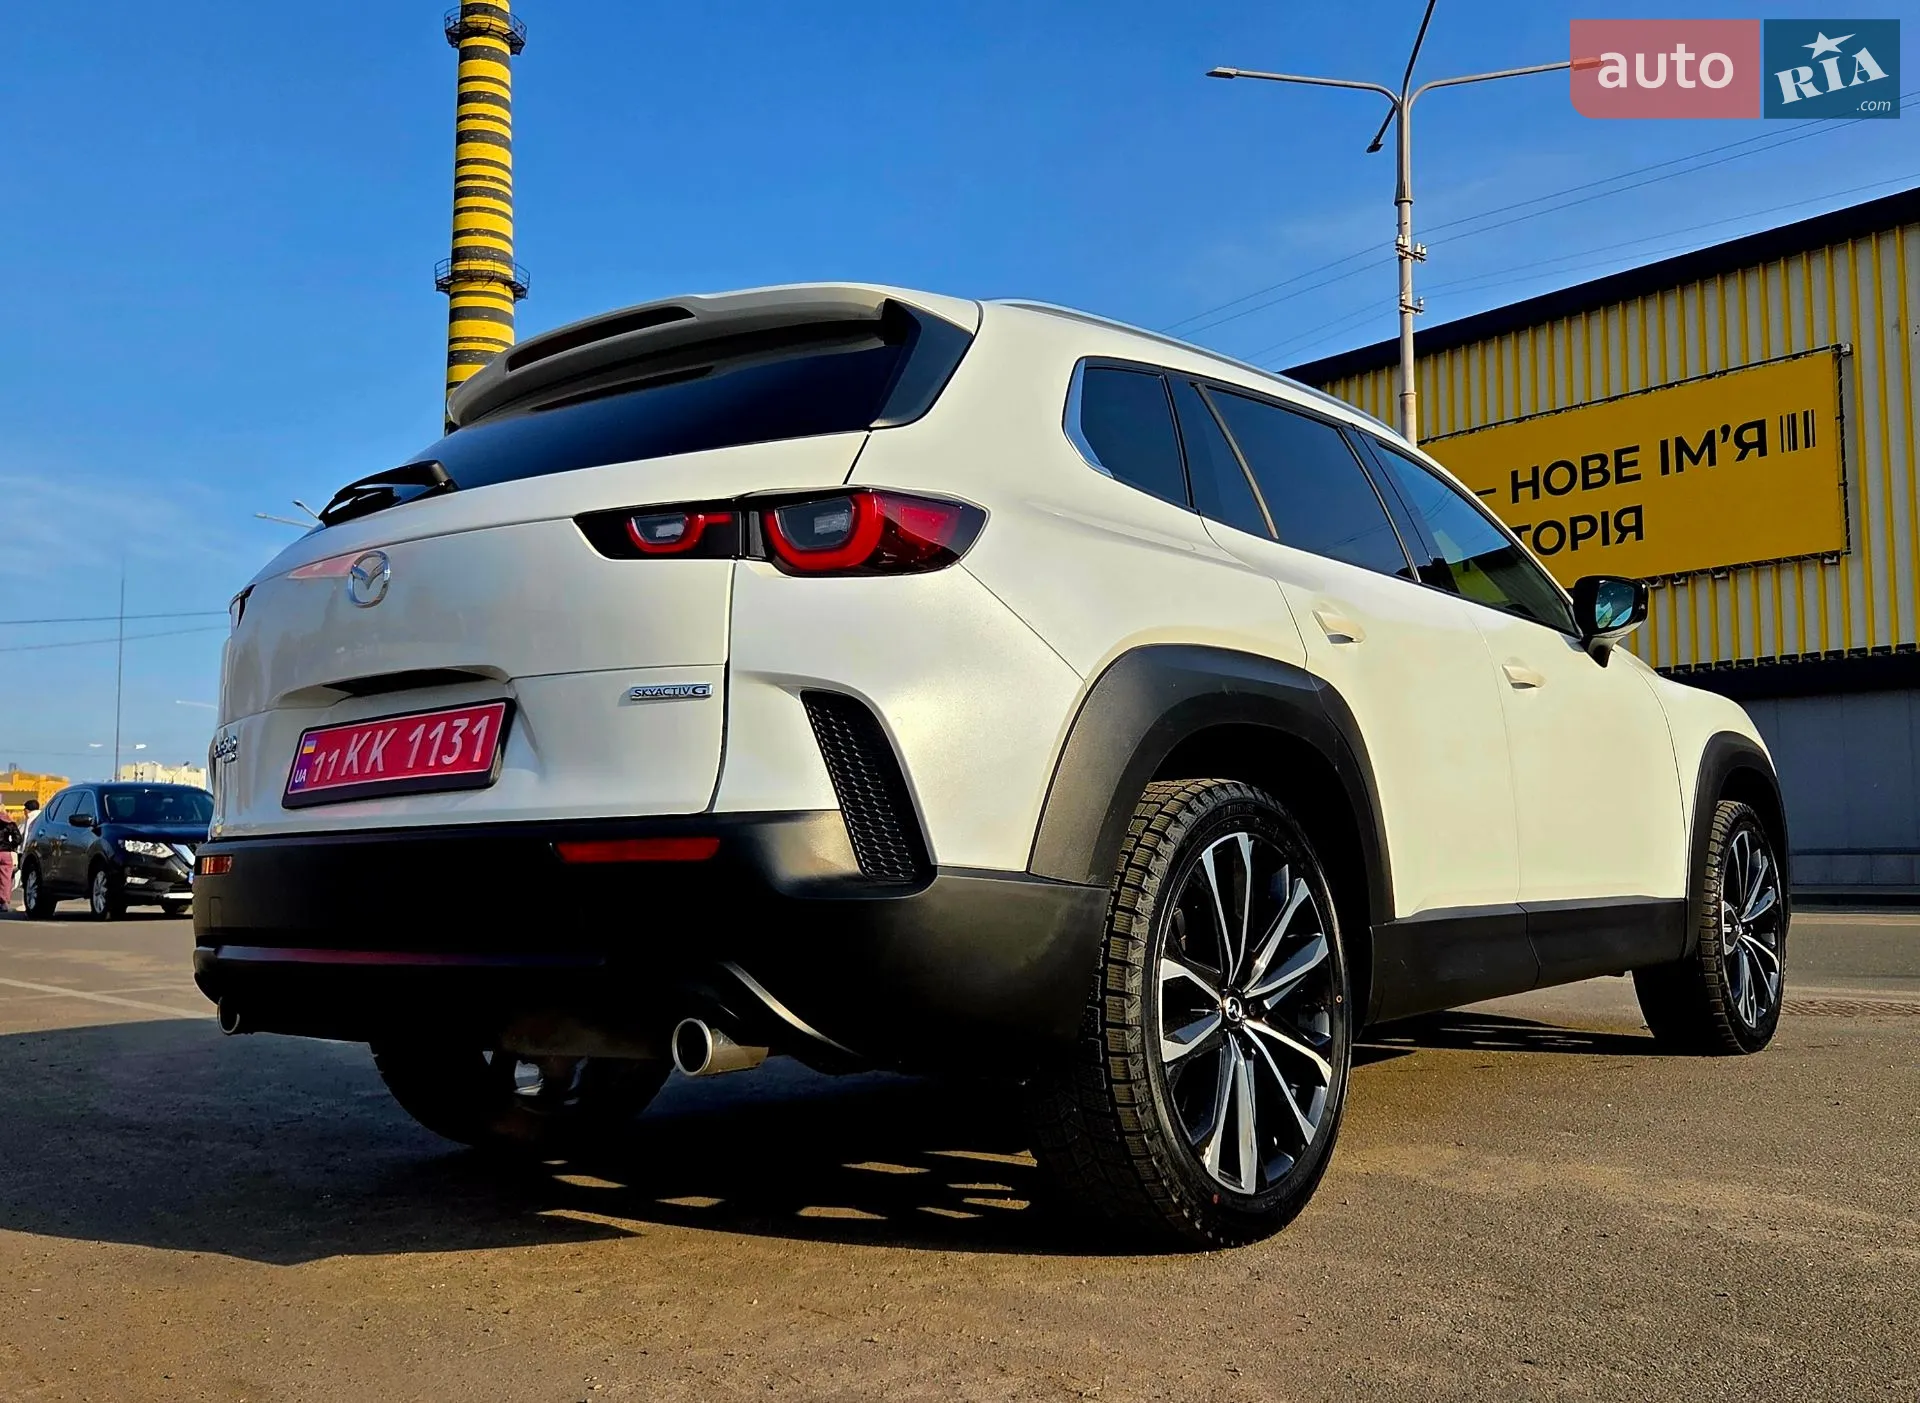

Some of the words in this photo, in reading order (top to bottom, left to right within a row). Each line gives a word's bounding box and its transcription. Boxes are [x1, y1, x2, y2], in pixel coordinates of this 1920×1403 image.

[1511, 445, 1641, 503] НОВЕ
[407, 715, 490, 769] 1131
[295, 769, 307, 783] UA
